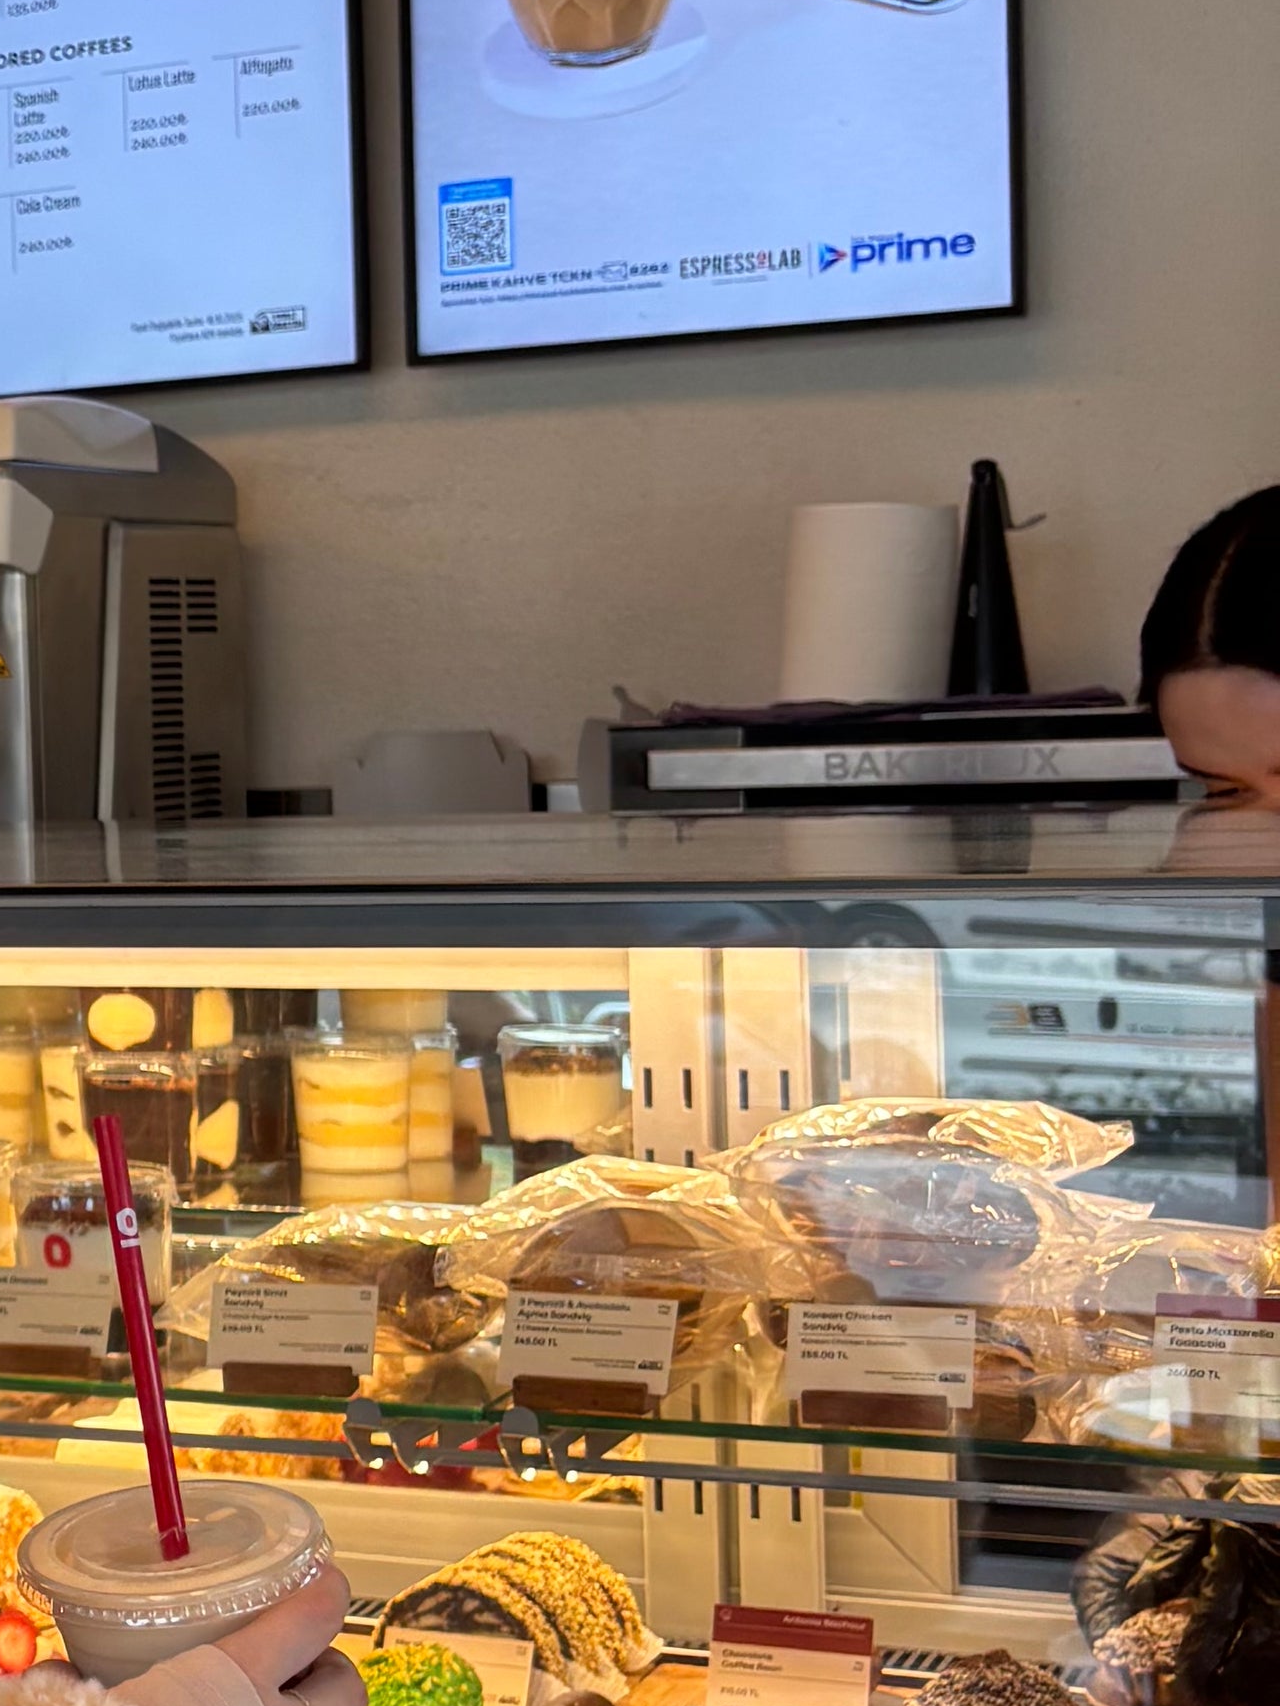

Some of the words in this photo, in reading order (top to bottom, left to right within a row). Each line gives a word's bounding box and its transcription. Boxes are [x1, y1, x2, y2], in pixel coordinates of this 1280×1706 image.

[49, 34, 134, 63] COFFEES
[680, 247, 802, 280] ESPRESSOLAB
[851, 232, 976, 274] prime
[845, 1310, 894, 1322] Chicken
[1169, 1323, 1205, 1335] Pesto
[1206, 1325, 1275, 1339] Mozzarella
[1207, 1369, 1221, 1381] TL
